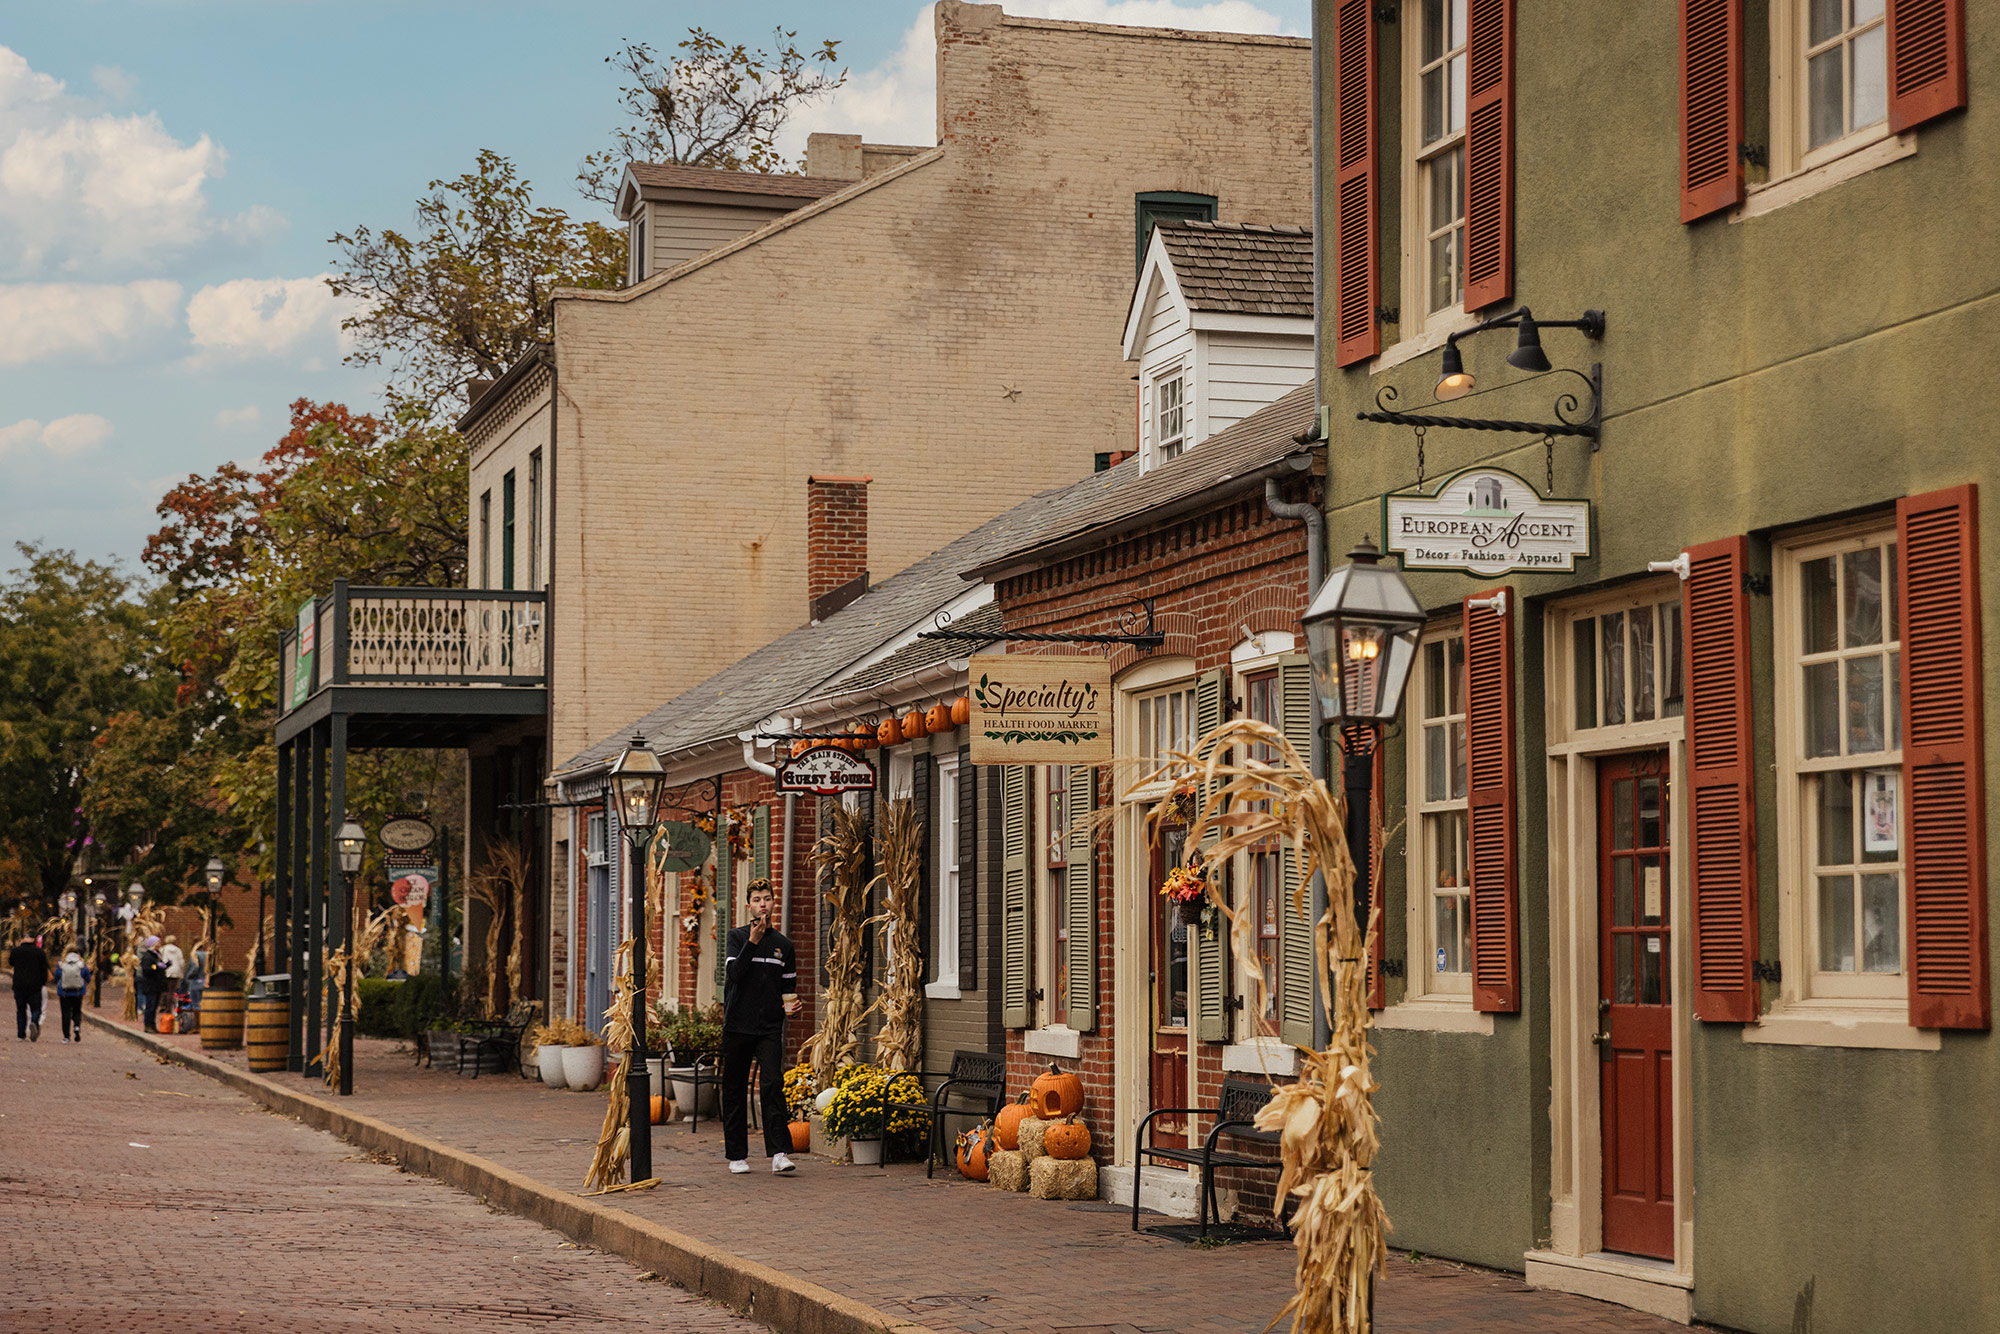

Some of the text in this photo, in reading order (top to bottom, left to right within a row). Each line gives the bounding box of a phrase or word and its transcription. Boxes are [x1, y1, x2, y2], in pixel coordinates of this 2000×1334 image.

[1401, 511, 1574, 549] EUROPEAN ACCENT
[1415, 548, 1562, 565] Décor Fashion Apparel
[985, 679, 1099, 718] Specialty's
[984, 720, 1100, 729] HEALTH FOOD MARKET
[796, 751, 858, 769] THE MAIN STREET
[783, 770, 872, 784] GUEST HOUSE
